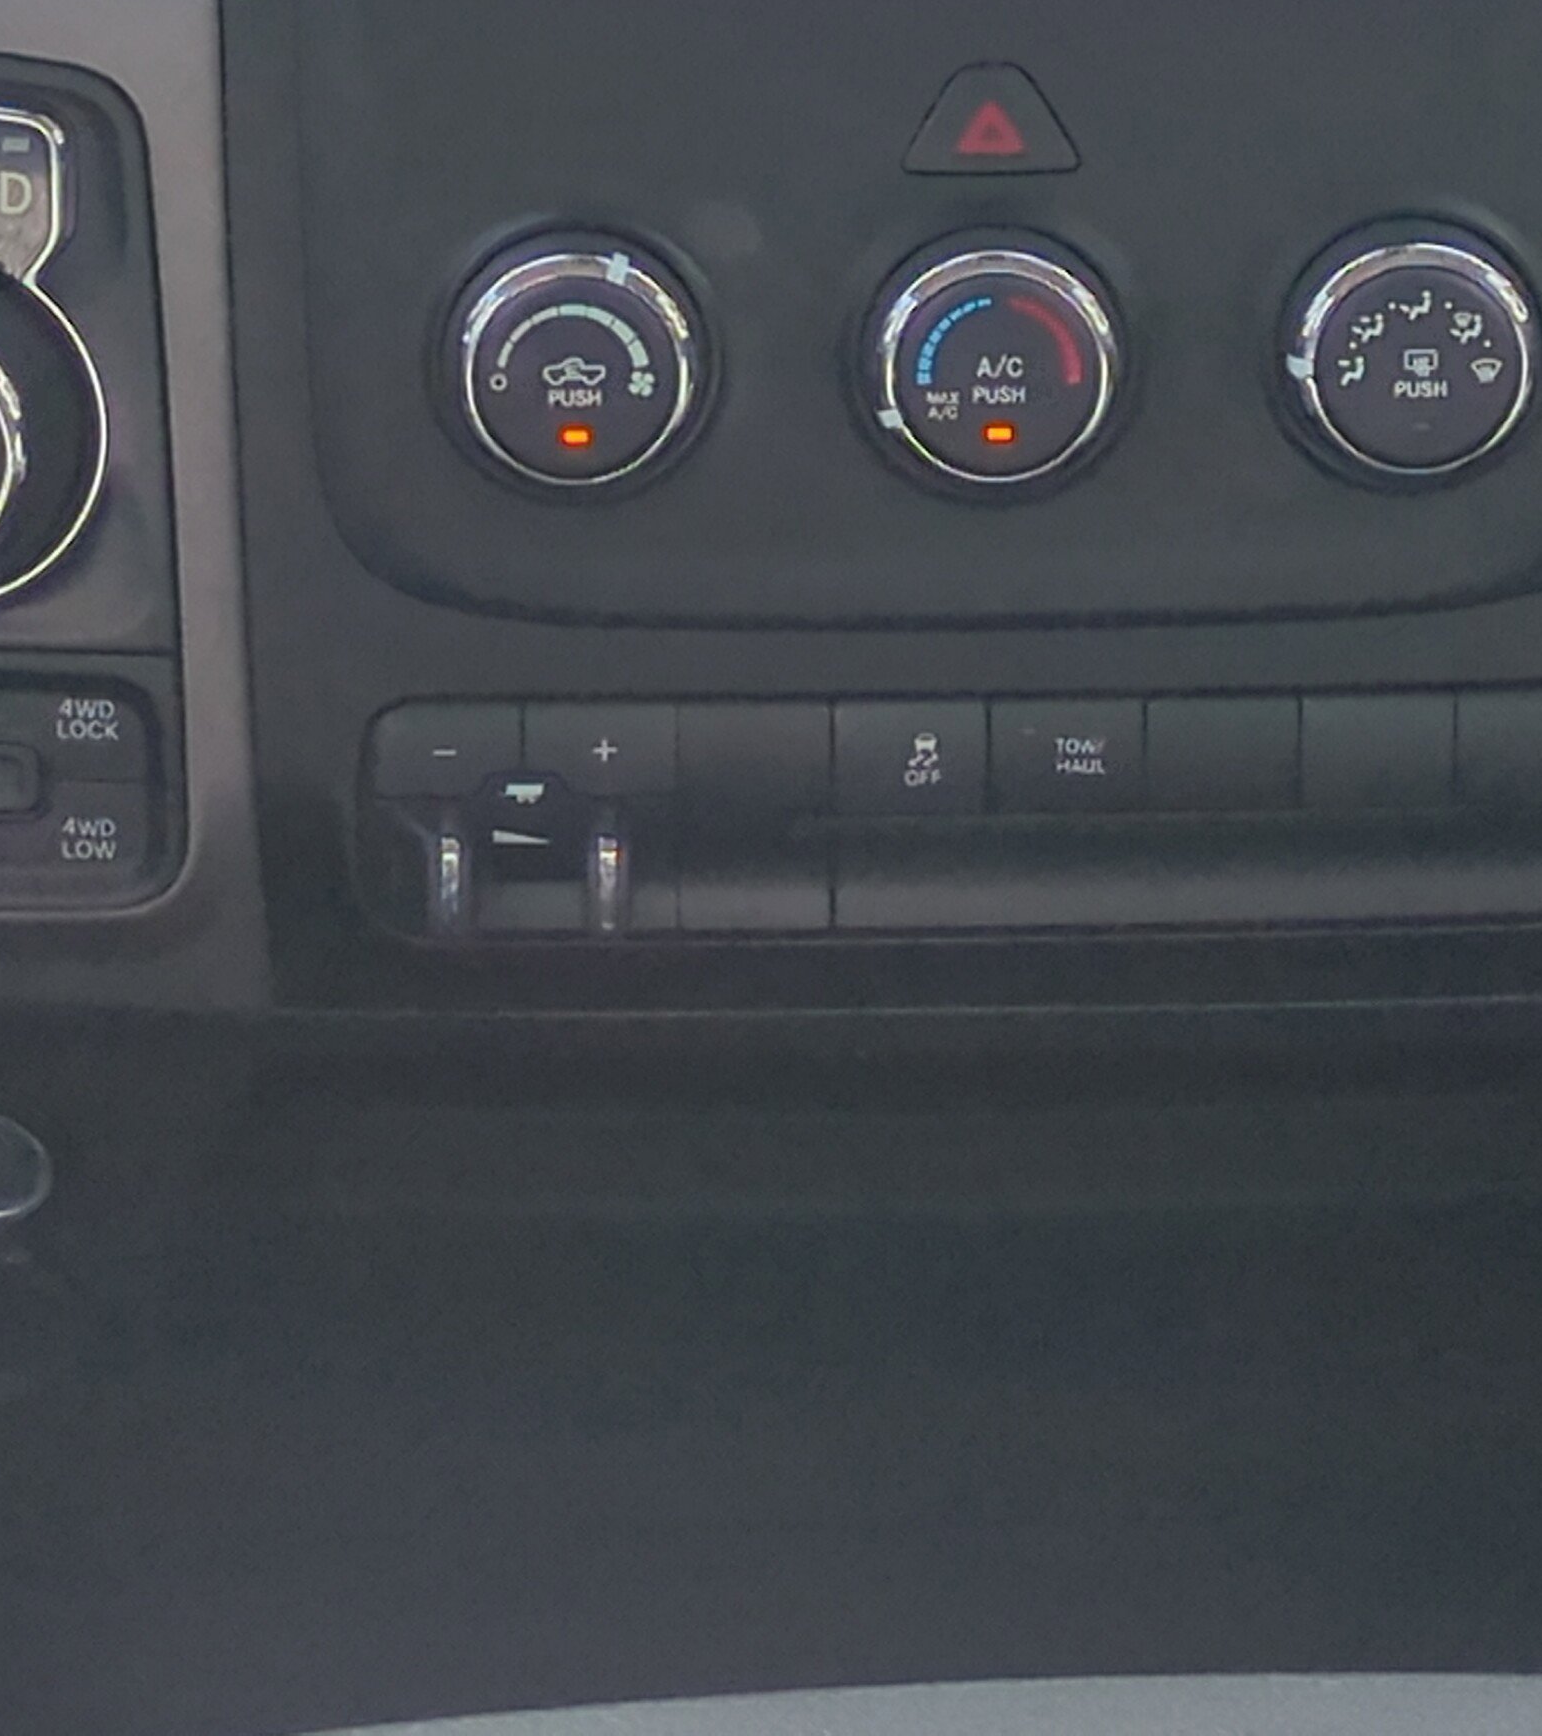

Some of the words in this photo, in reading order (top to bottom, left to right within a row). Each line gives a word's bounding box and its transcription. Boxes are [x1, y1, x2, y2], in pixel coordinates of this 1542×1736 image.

[976, 355, 1024, 380] A/C
[547, 389, 602, 407] PUSH
[926, 391, 960, 405] MAX
[971, 386, 1026, 405] PUSH
[1393, 380, 1449, 399] PUSH
[927, 405, 959, 420] A/C
[57, 697, 117, 719] 4WD
[55, 719, 120, 741] LOCK
[1056, 758, 1106, 775] HAUL
[904, 769, 942, 787] OFF
[60, 816, 117, 837] 4WD
[60, 839, 117, 860] LOW
